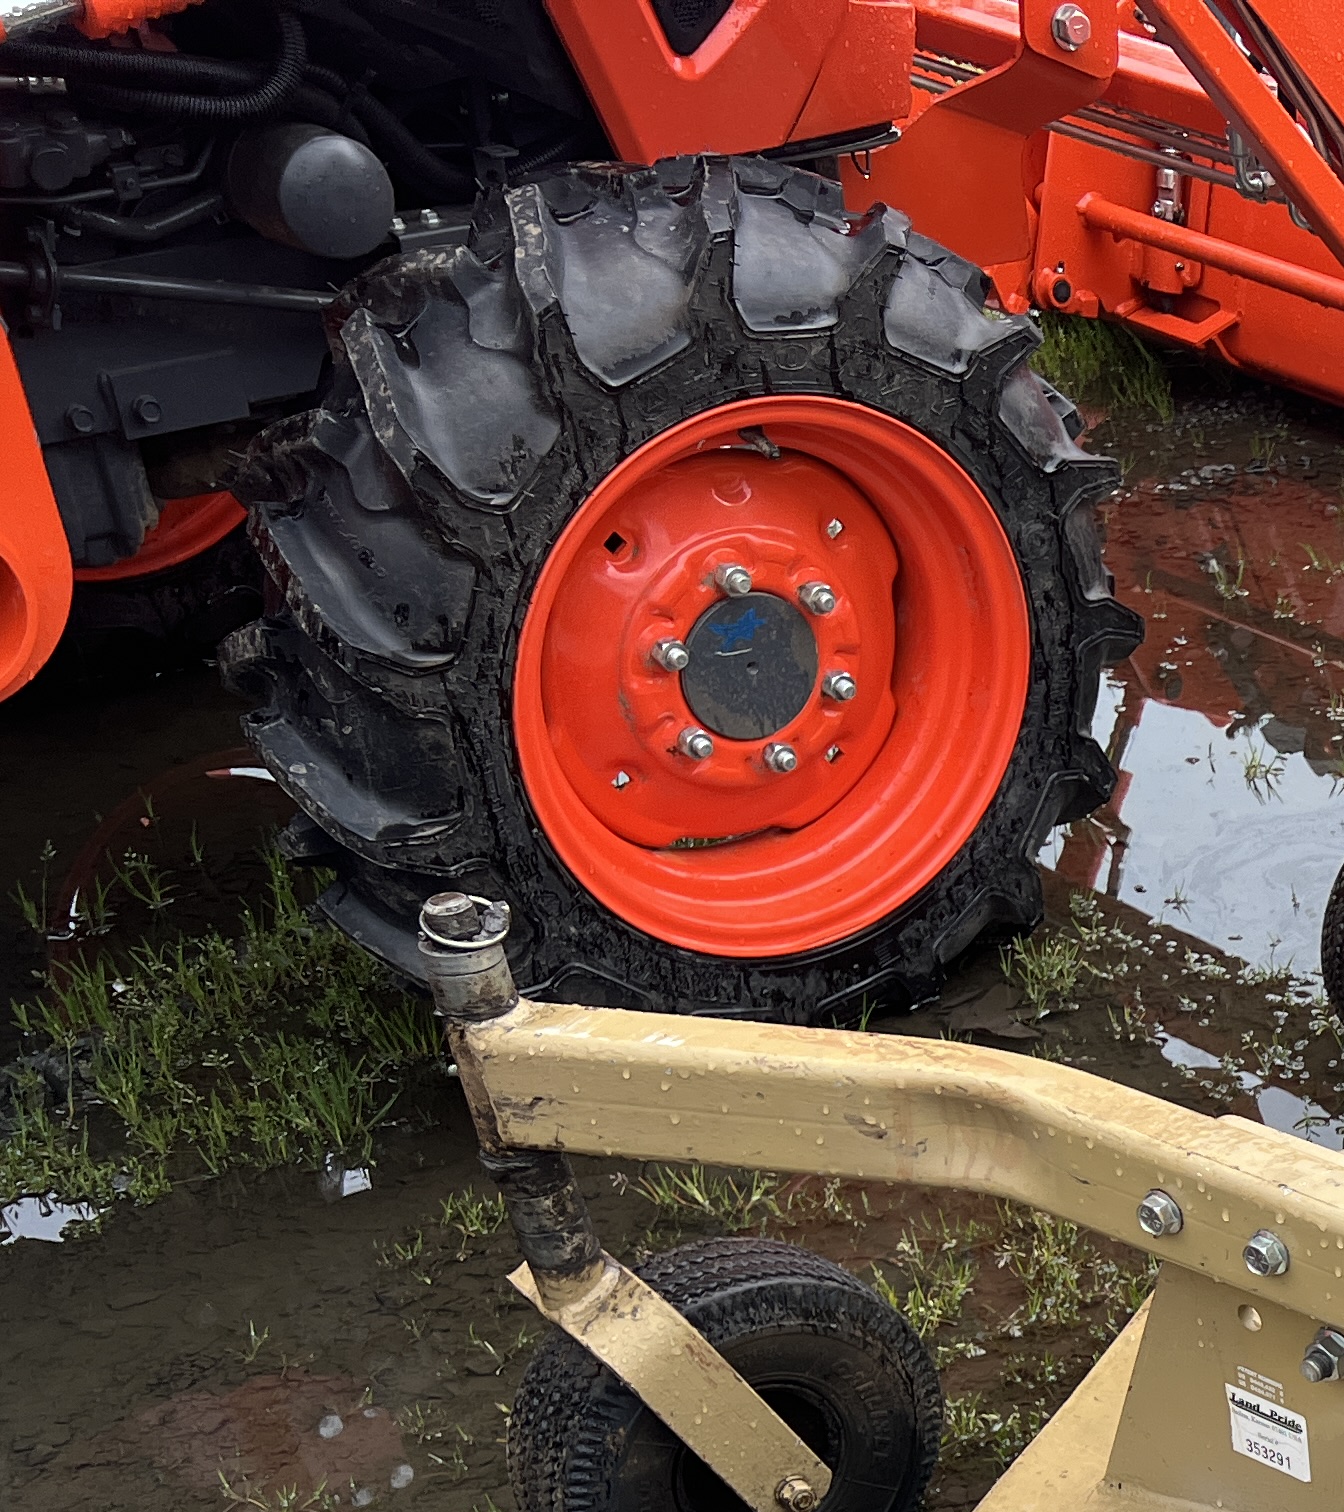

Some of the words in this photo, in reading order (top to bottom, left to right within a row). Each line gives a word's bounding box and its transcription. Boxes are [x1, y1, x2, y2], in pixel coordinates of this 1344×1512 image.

[1229, 1392, 1261, 1414] Land
[1268, 1408, 1303, 1433] Pride
[1245, 1437, 1291, 1471] 353291
